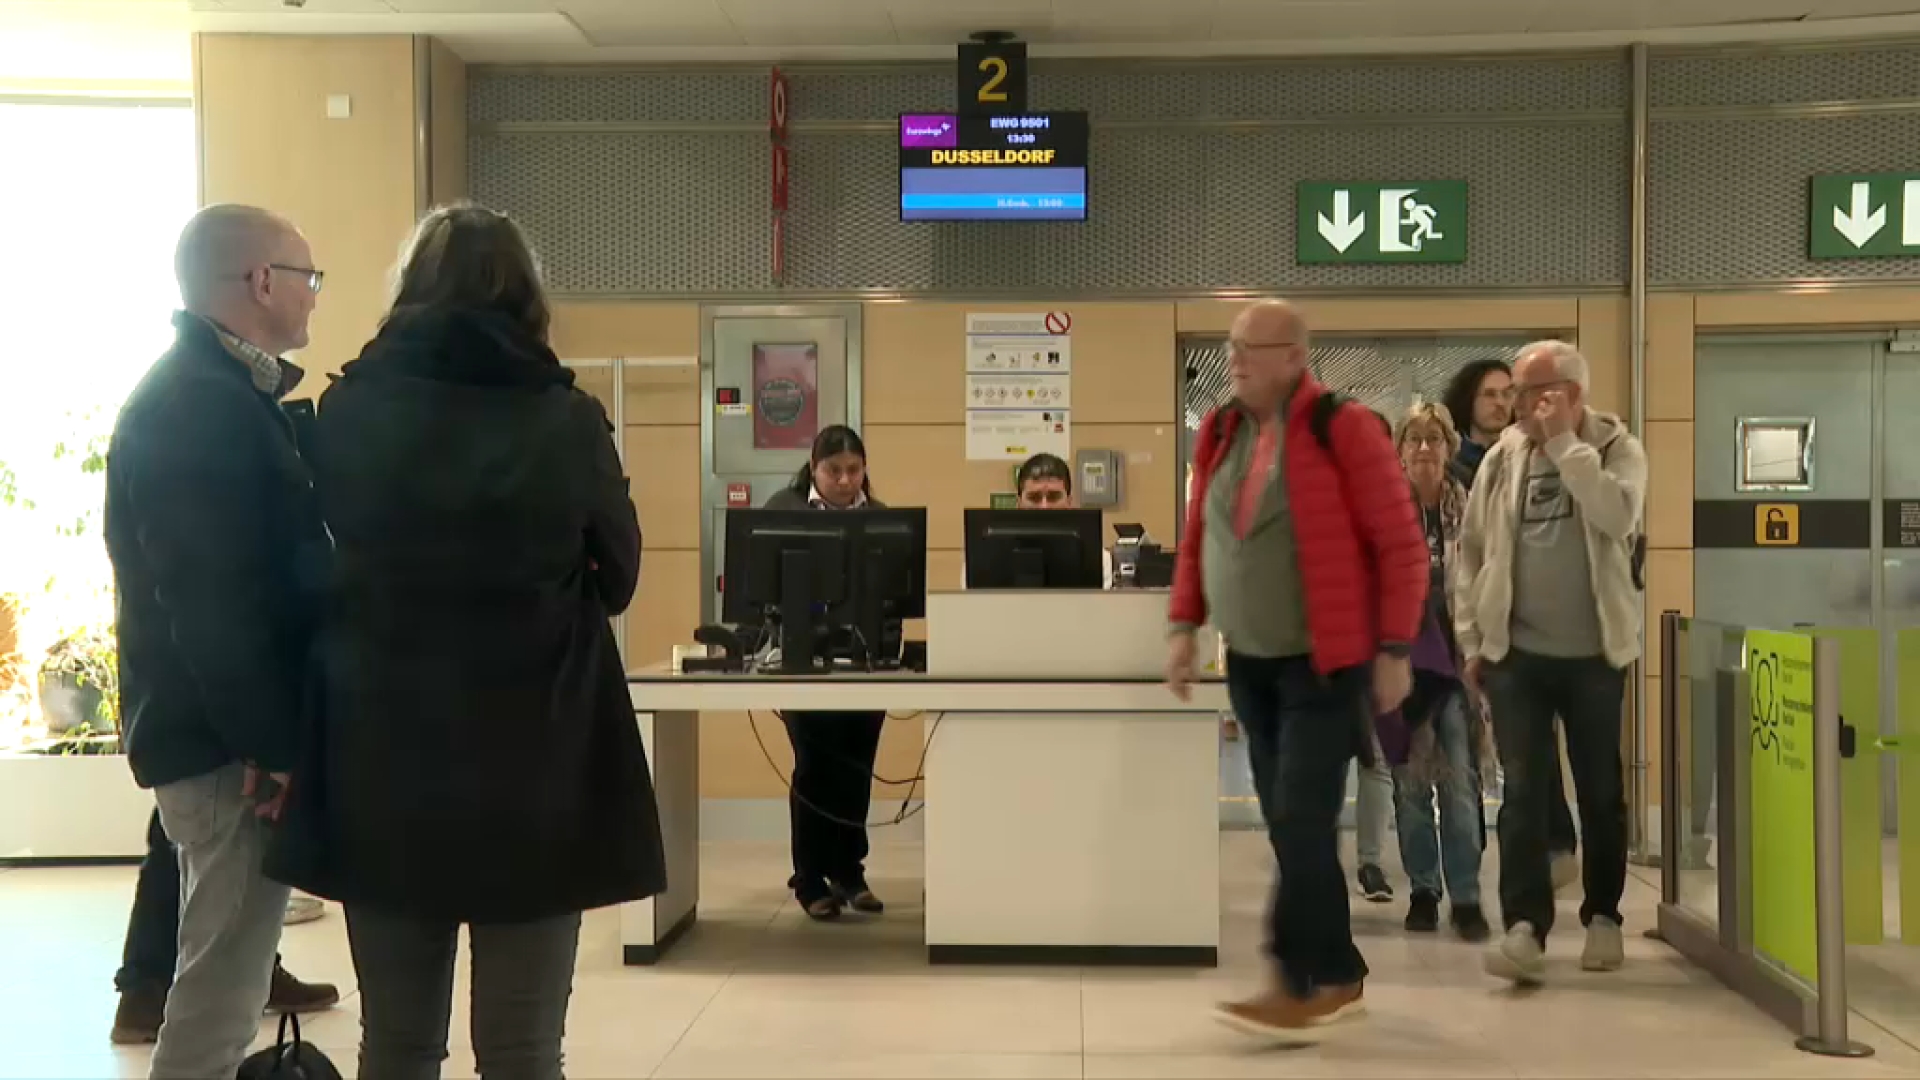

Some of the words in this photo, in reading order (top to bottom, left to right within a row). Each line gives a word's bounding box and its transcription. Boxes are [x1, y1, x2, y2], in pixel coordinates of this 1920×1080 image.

[978, 57, 1008, 102] 2
[990, 116, 1018, 128] EWG
[931, 150, 1056, 164] DUSSELDORF
